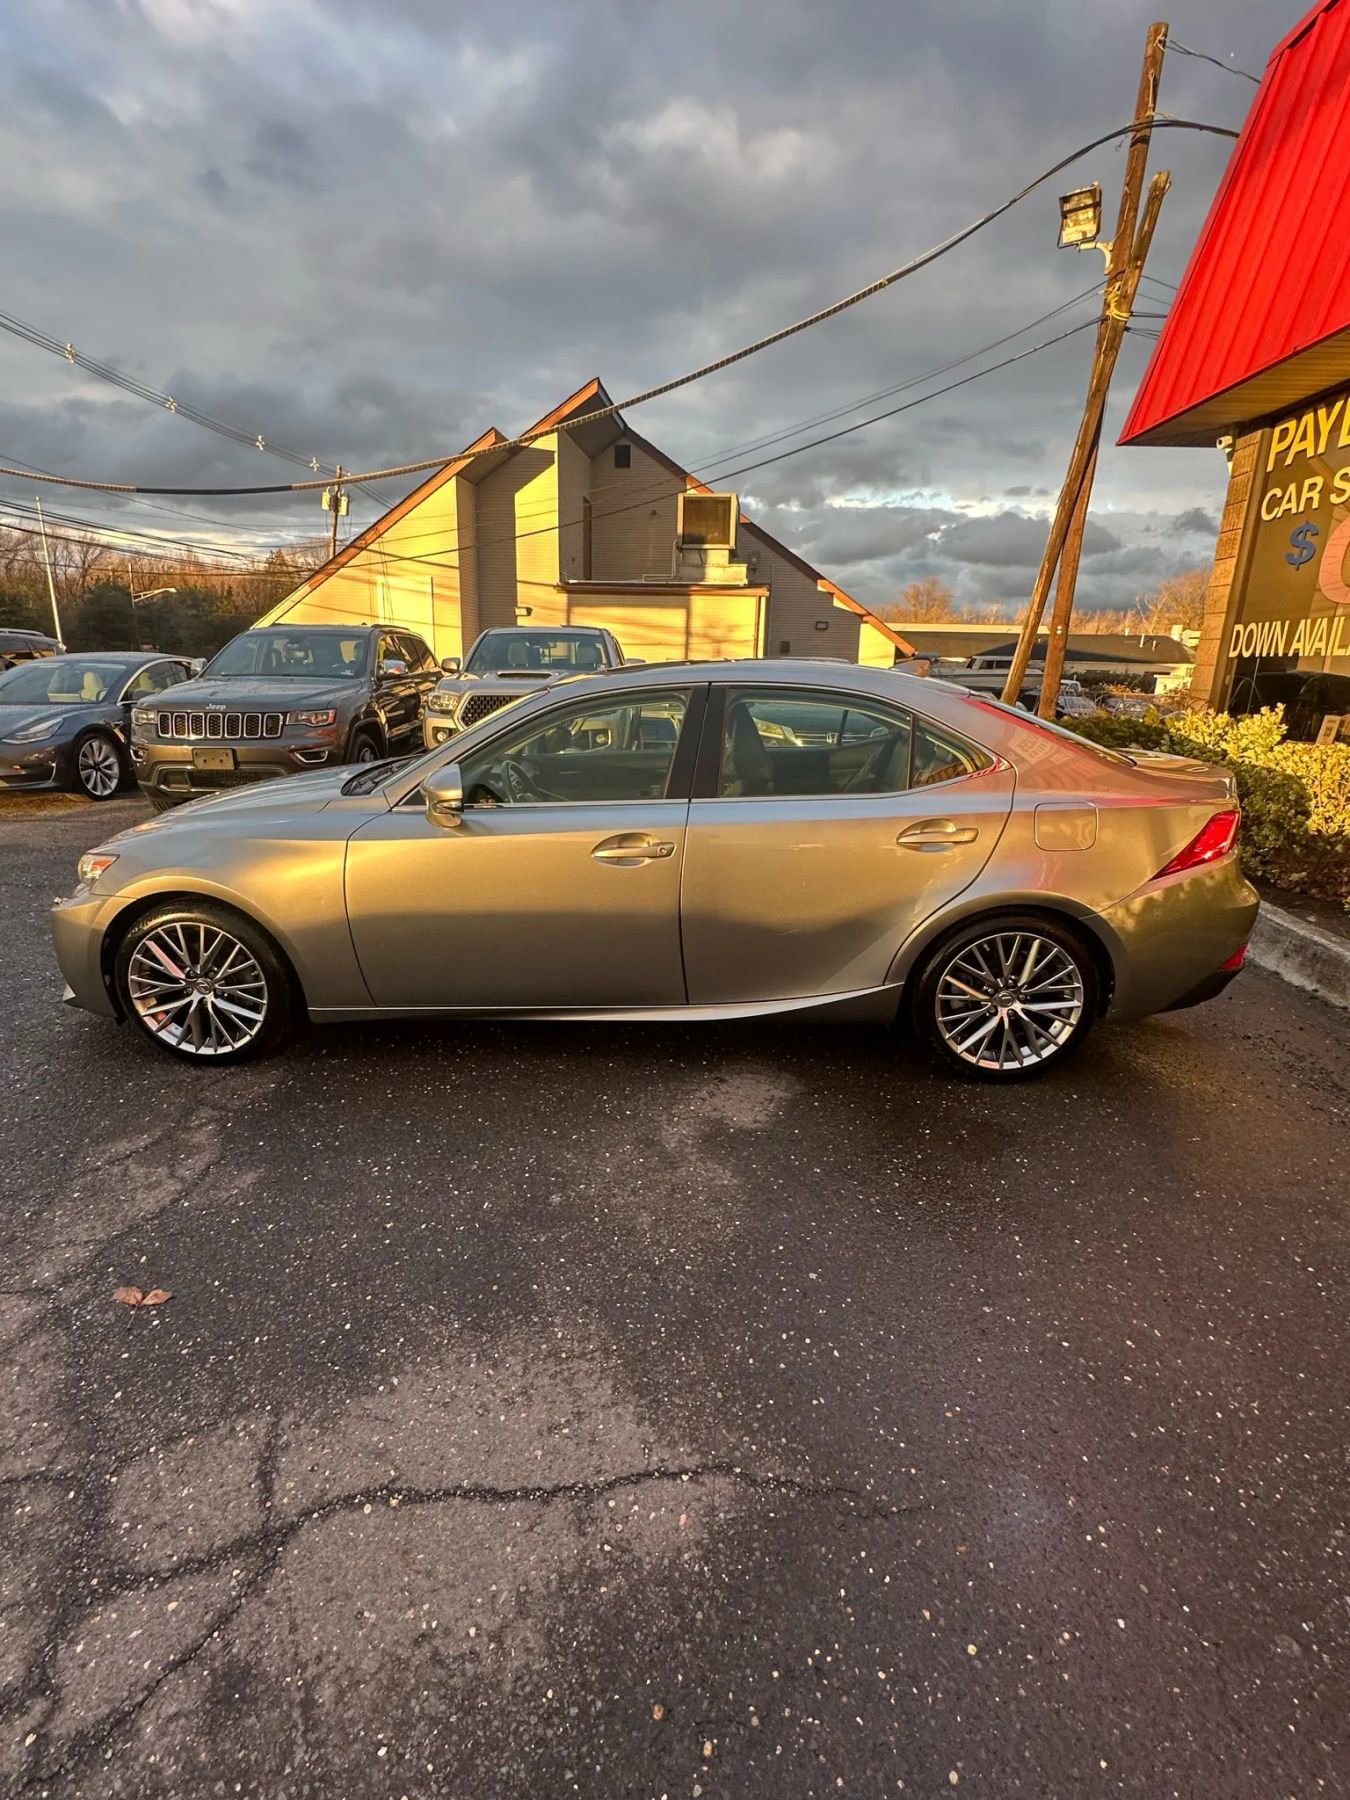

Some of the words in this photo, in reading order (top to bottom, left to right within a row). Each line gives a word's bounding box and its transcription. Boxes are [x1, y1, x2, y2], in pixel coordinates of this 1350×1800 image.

[1261, 475, 1324, 521] CAR
[1228, 620, 1290, 658] DOWN
[1288, 616, 1350, 657] AVAIL
[205, 703, 226, 711] Jeep
